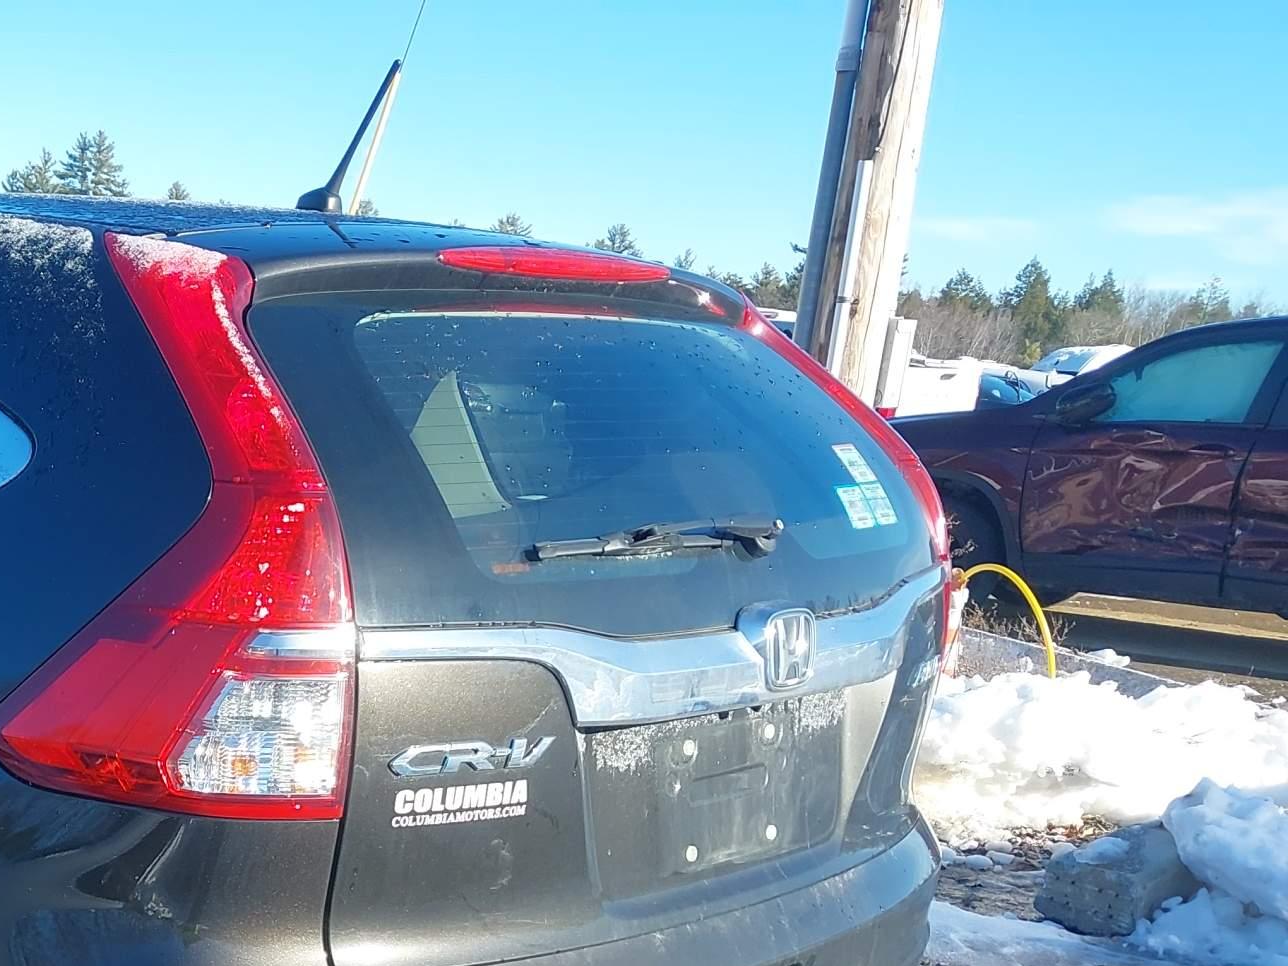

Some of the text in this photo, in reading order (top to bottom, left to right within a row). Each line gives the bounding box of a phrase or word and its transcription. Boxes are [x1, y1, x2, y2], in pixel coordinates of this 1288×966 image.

[387, 735, 557, 777] CR-V
[394, 779, 528, 814] COLUMBIA
[391, 804, 528, 828] COLUMBIAMOTORS.COM
